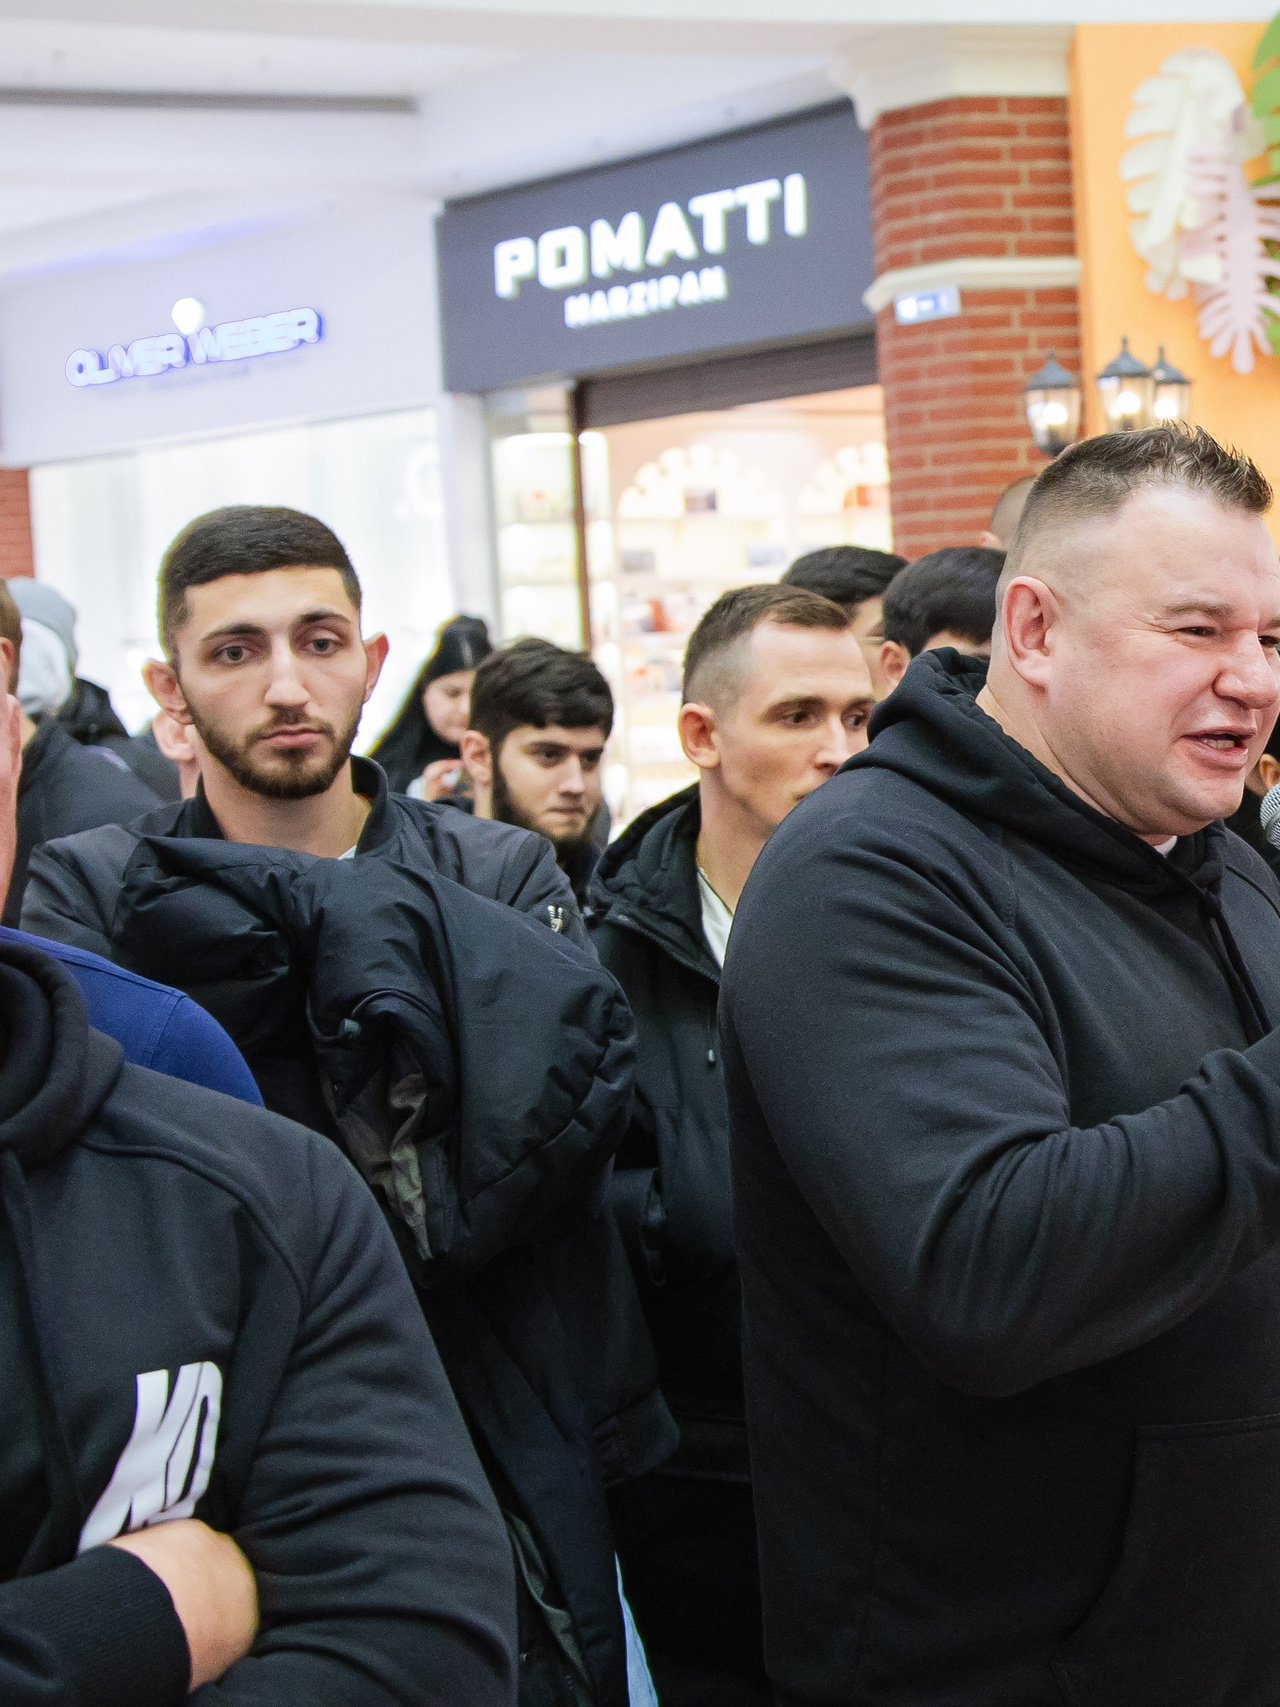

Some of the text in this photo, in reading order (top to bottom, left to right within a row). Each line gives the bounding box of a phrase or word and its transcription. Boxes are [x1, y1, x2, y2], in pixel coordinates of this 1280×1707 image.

[493, 172, 806, 299] POMATTI
[563, 265, 728, 329] MARZIPAN
[65, 307, 321, 387] OLIVER WEBER
